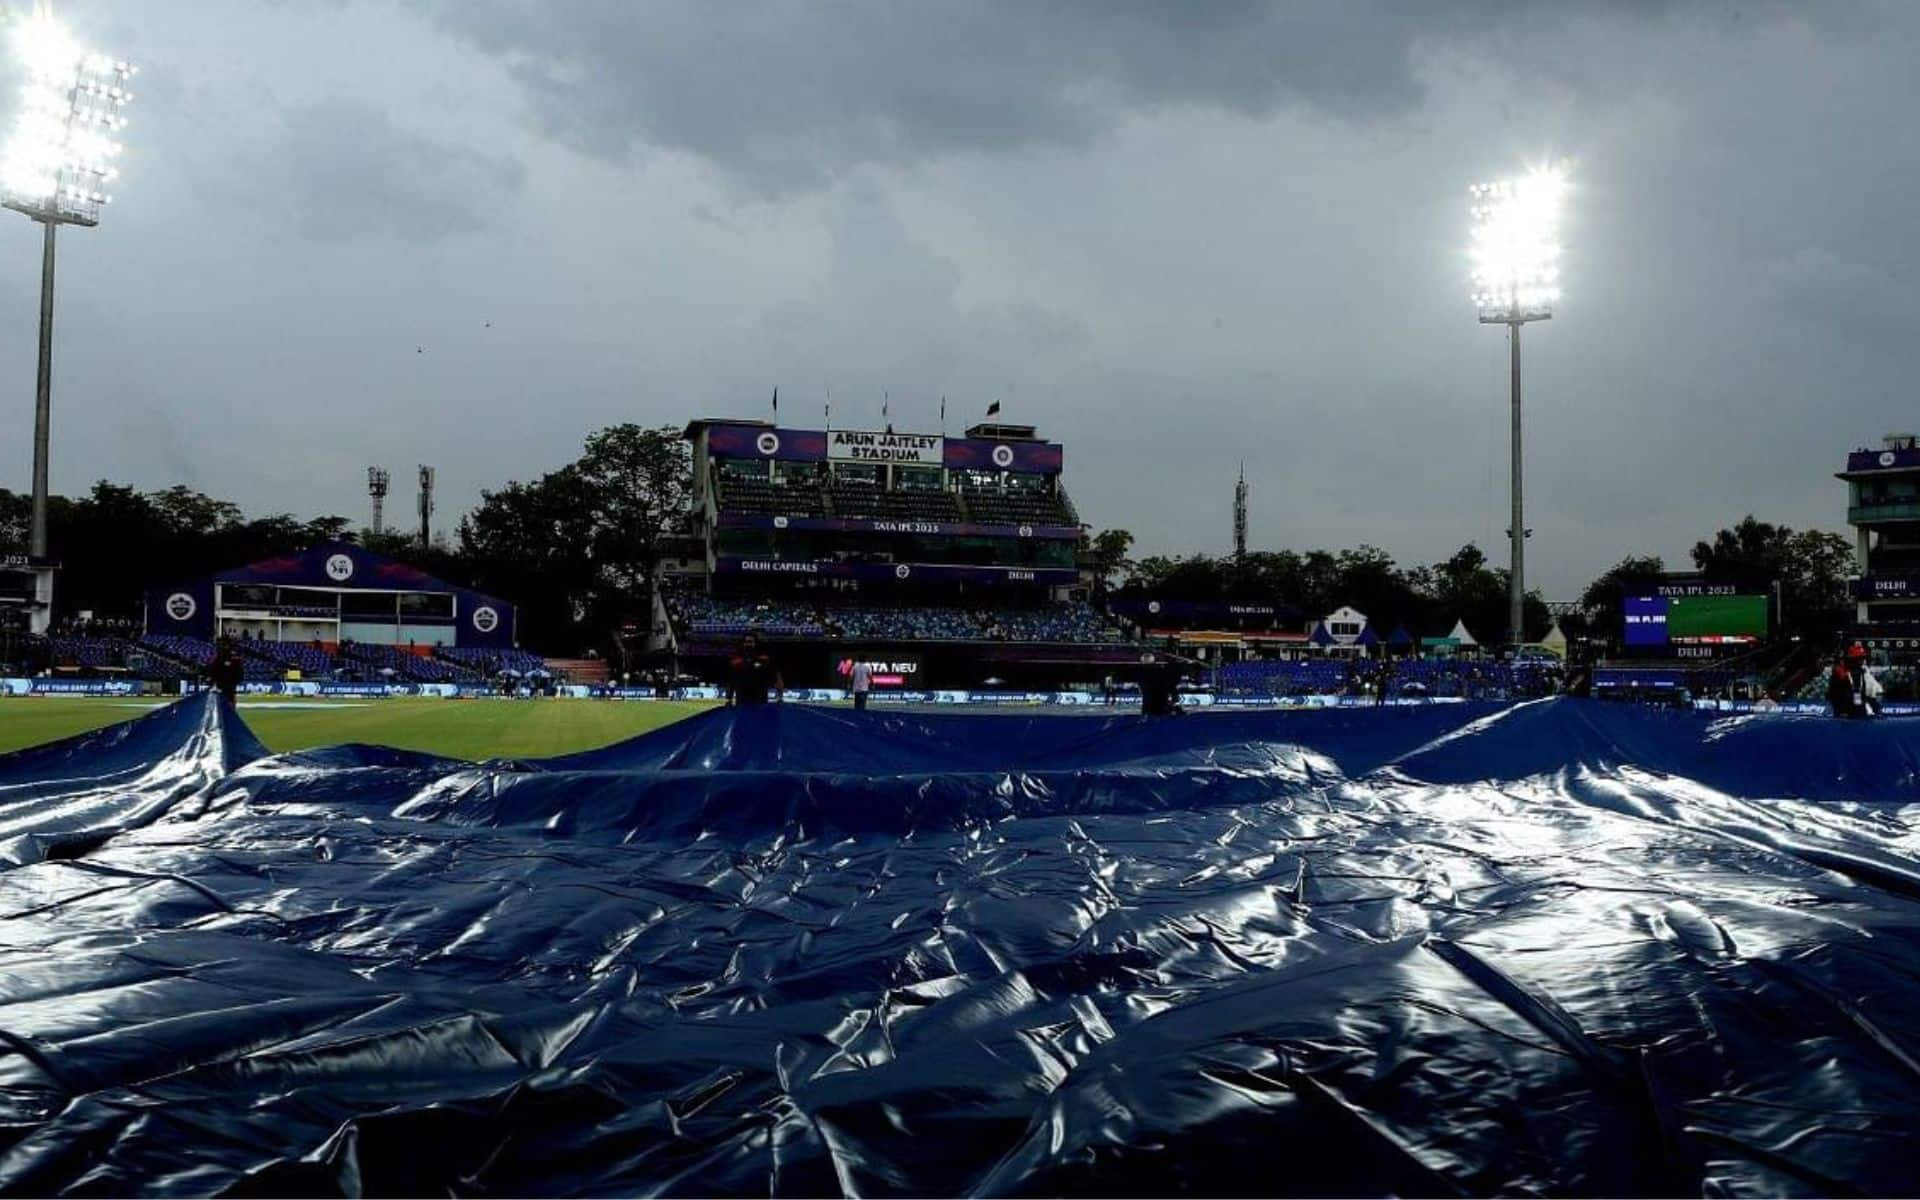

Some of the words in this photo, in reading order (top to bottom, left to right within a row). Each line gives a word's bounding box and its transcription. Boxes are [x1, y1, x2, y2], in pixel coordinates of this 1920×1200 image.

[835, 433, 874, 445] ARUN
[878, 436, 936, 449] JAITLEY
[851, 447, 920, 460] STADIUM
[741, 560, 770, 571] DELHI
[772, 562, 817, 573] CAPITALS
[1657, 585, 1685, 597] TATA
[1687, 586, 1702, 596] IPL
[1875, 580, 1907, 591] DELHI
[1677, 647, 1712, 658] DELHI
[891, 662, 917, 673] NEU
